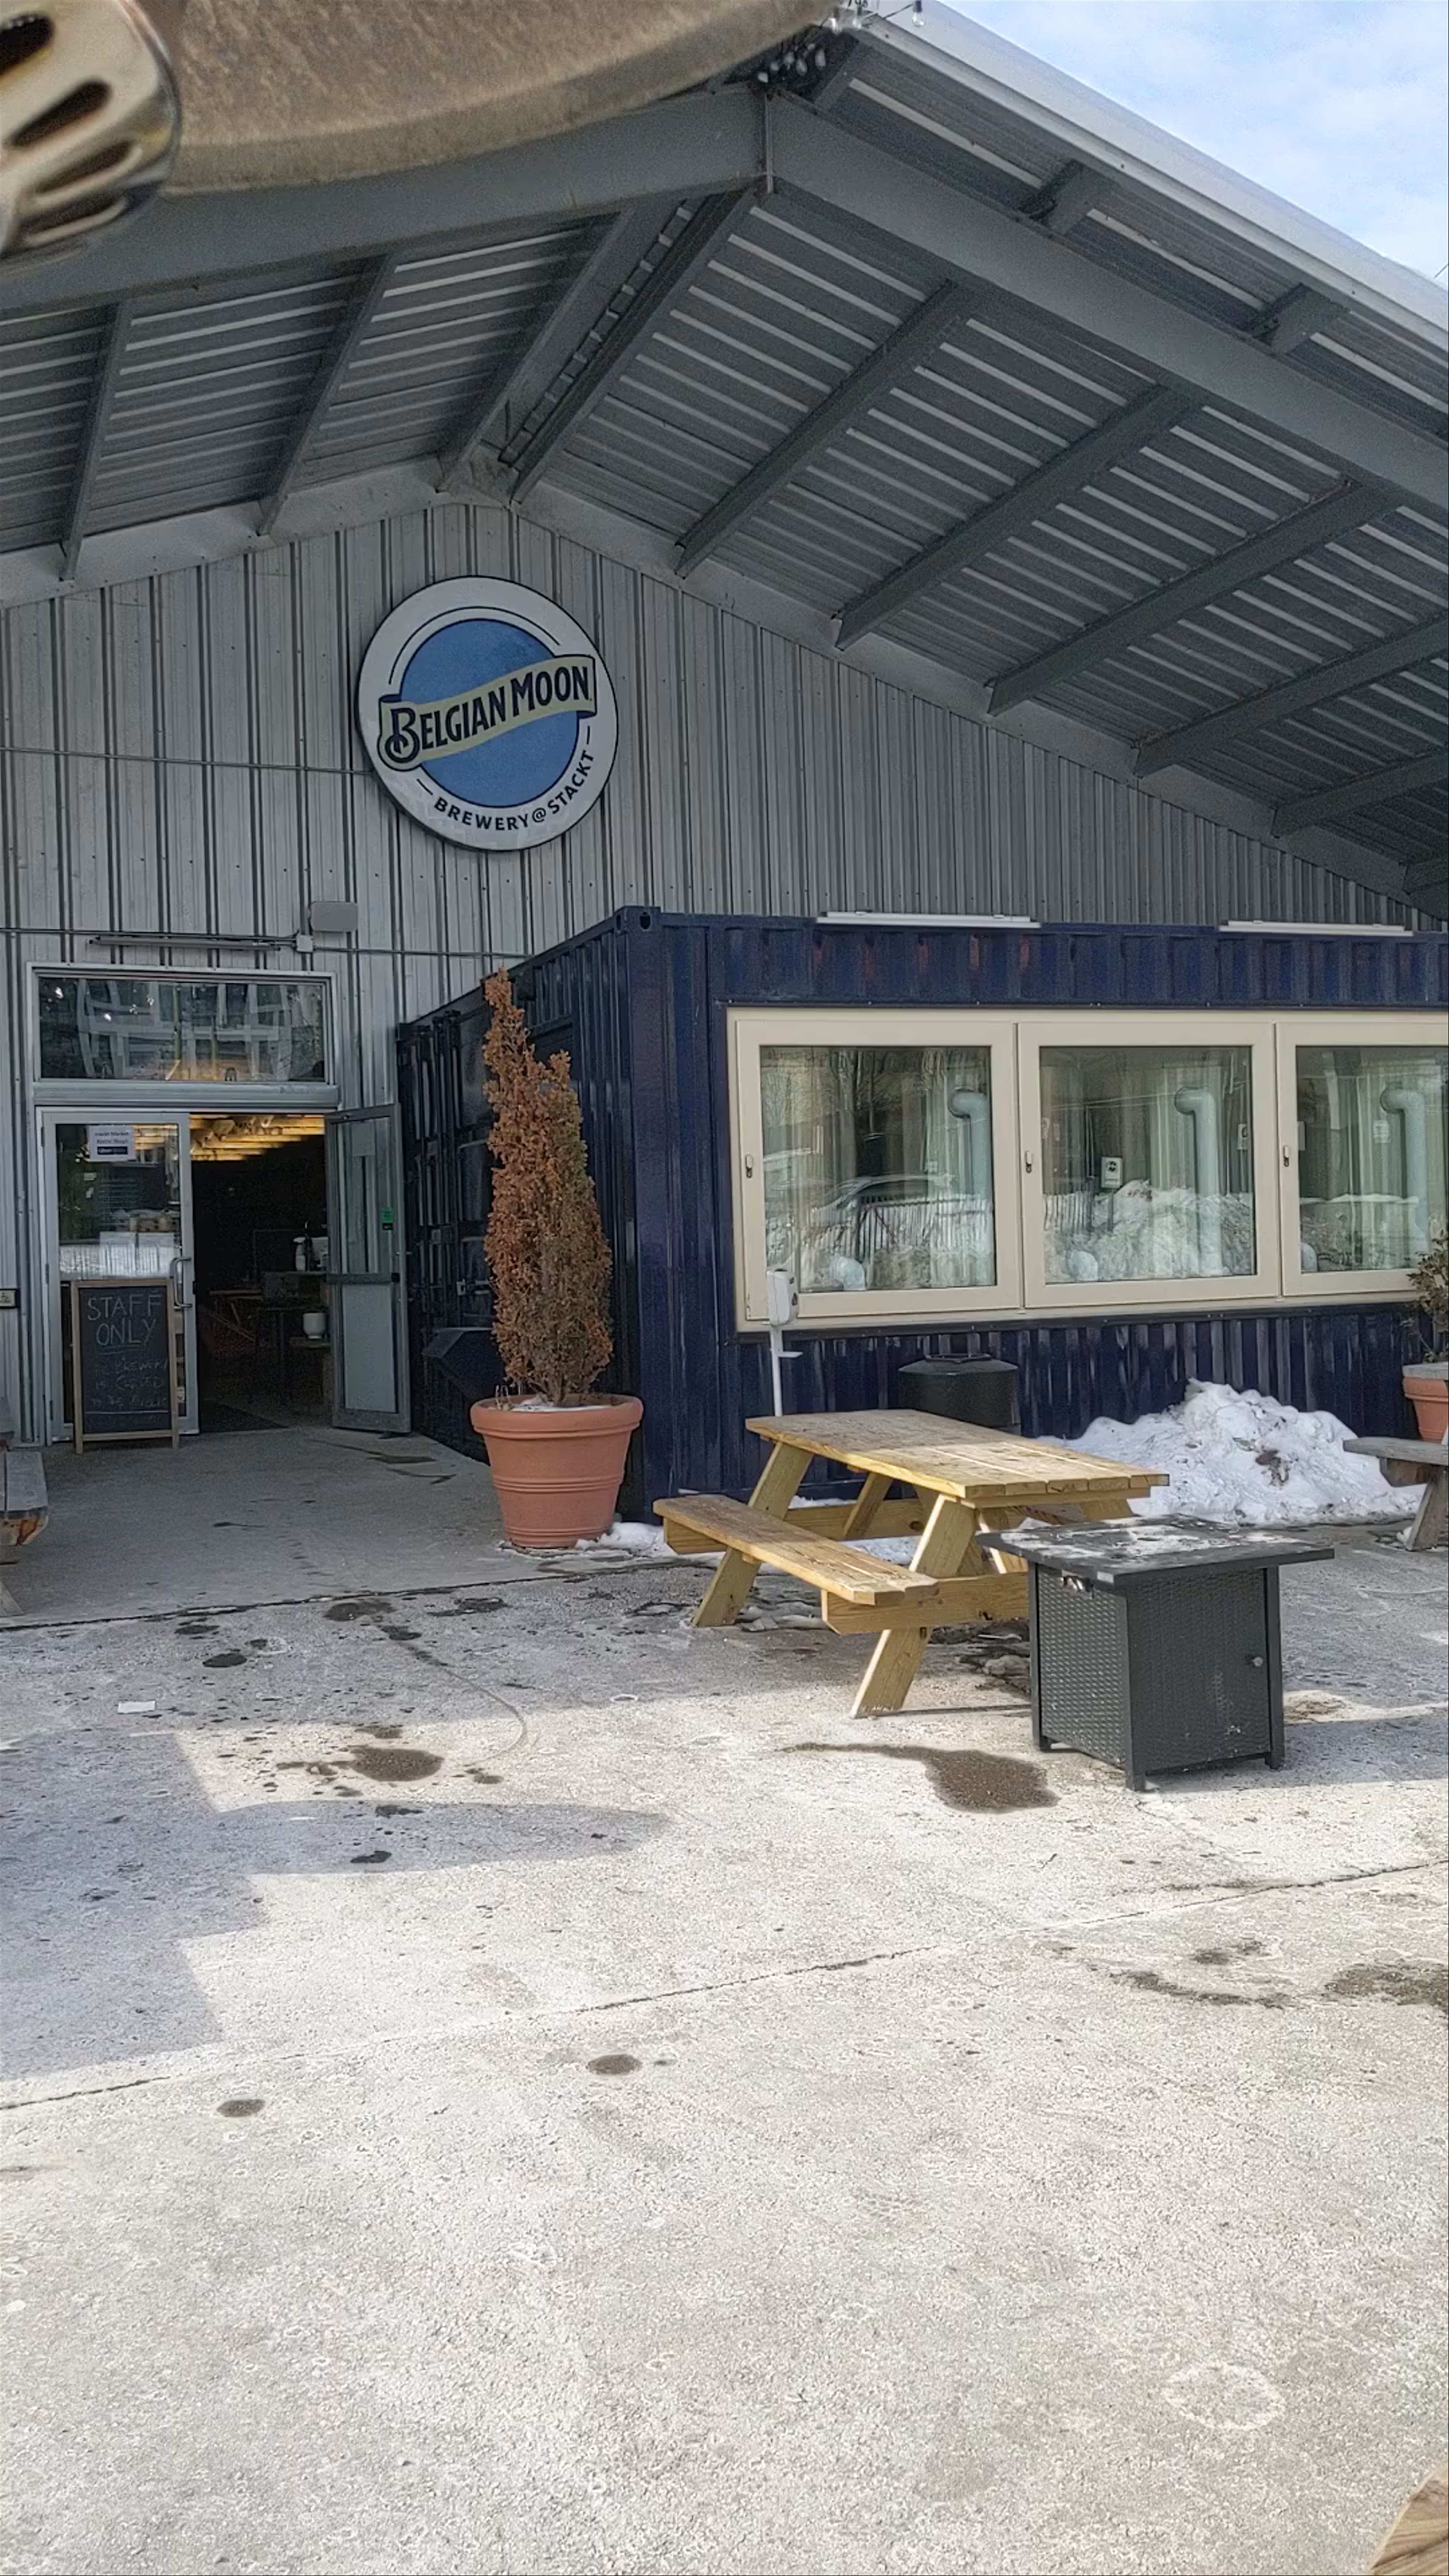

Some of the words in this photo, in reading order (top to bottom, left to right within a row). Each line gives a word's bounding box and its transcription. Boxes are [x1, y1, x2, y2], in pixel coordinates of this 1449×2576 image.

[385, 686, 506, 764] BELGIAN
[511, 666, 590, 718] MOON
[88, 1293, 162, 1320] STAFF
[96, 1318, 156, 1346] ONLY
